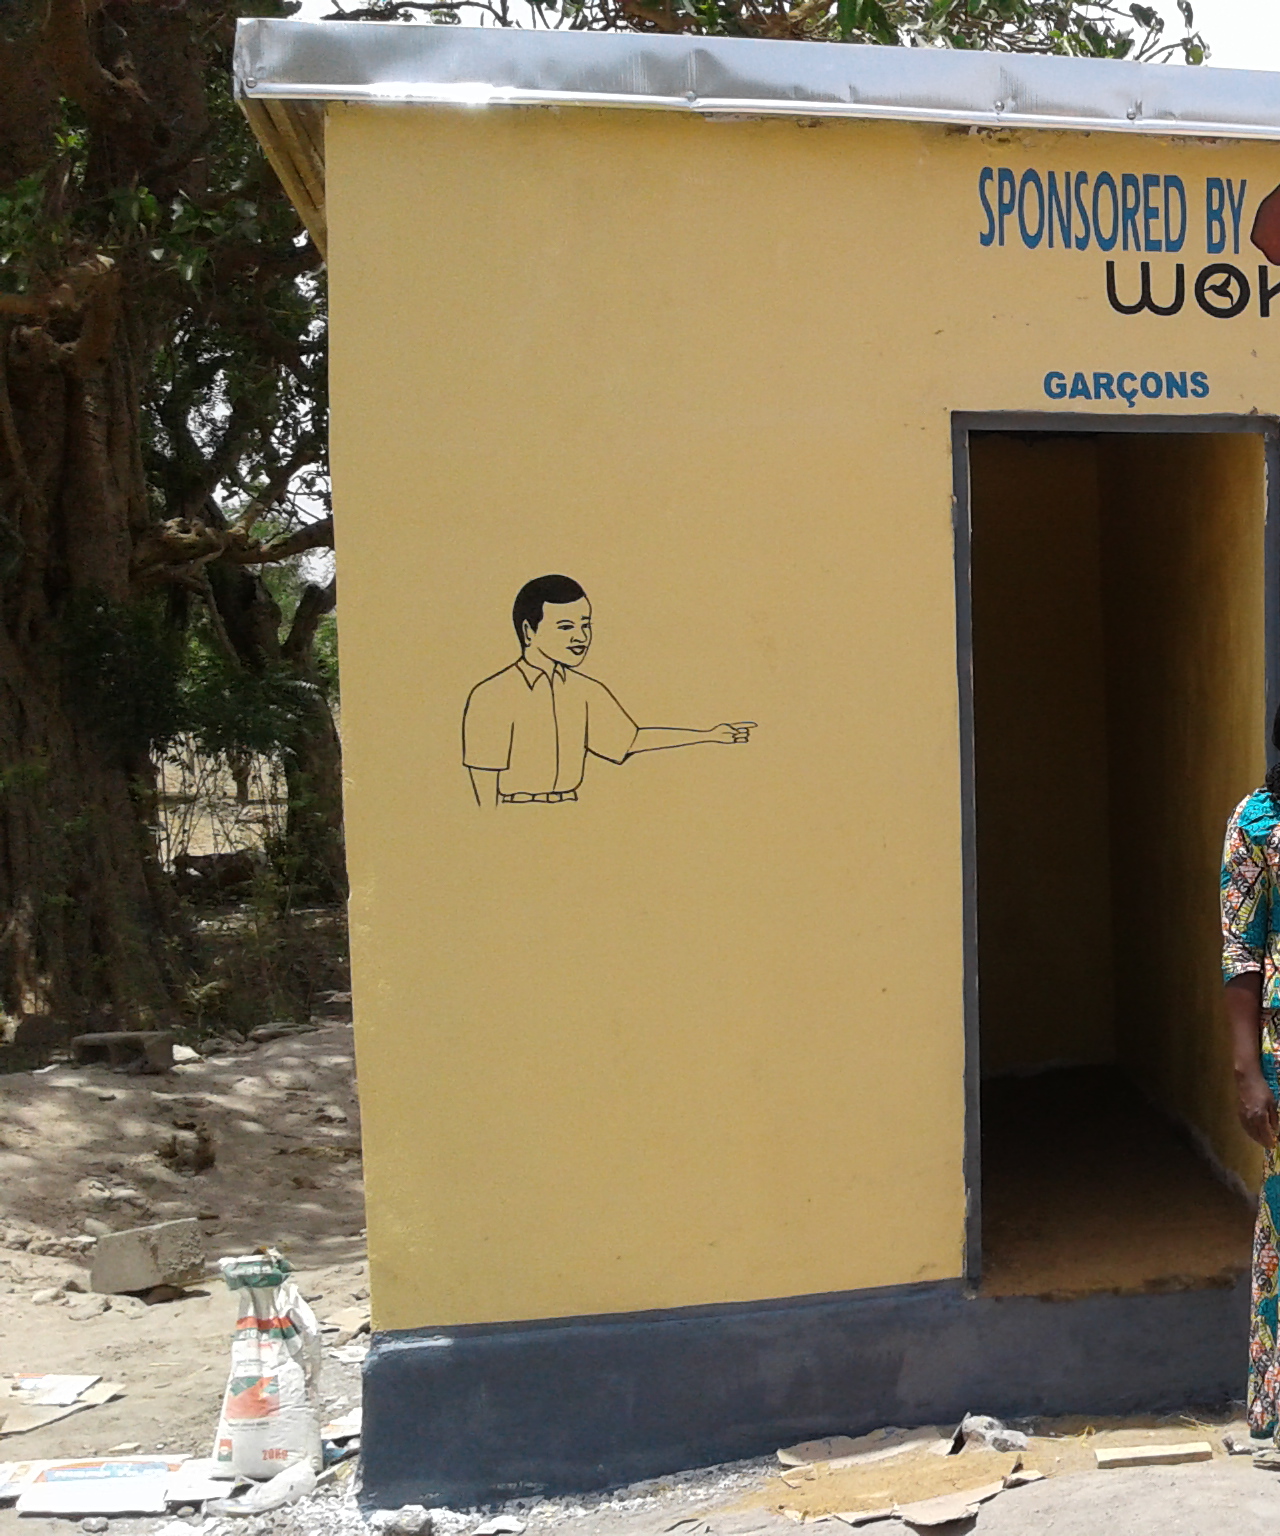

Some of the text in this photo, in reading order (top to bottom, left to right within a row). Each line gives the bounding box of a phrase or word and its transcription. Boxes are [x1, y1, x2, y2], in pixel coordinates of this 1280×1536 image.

[979, 167, 1248, 255] SPONSORED BY
[1043, 371, 1211, 408] GARÇONS
